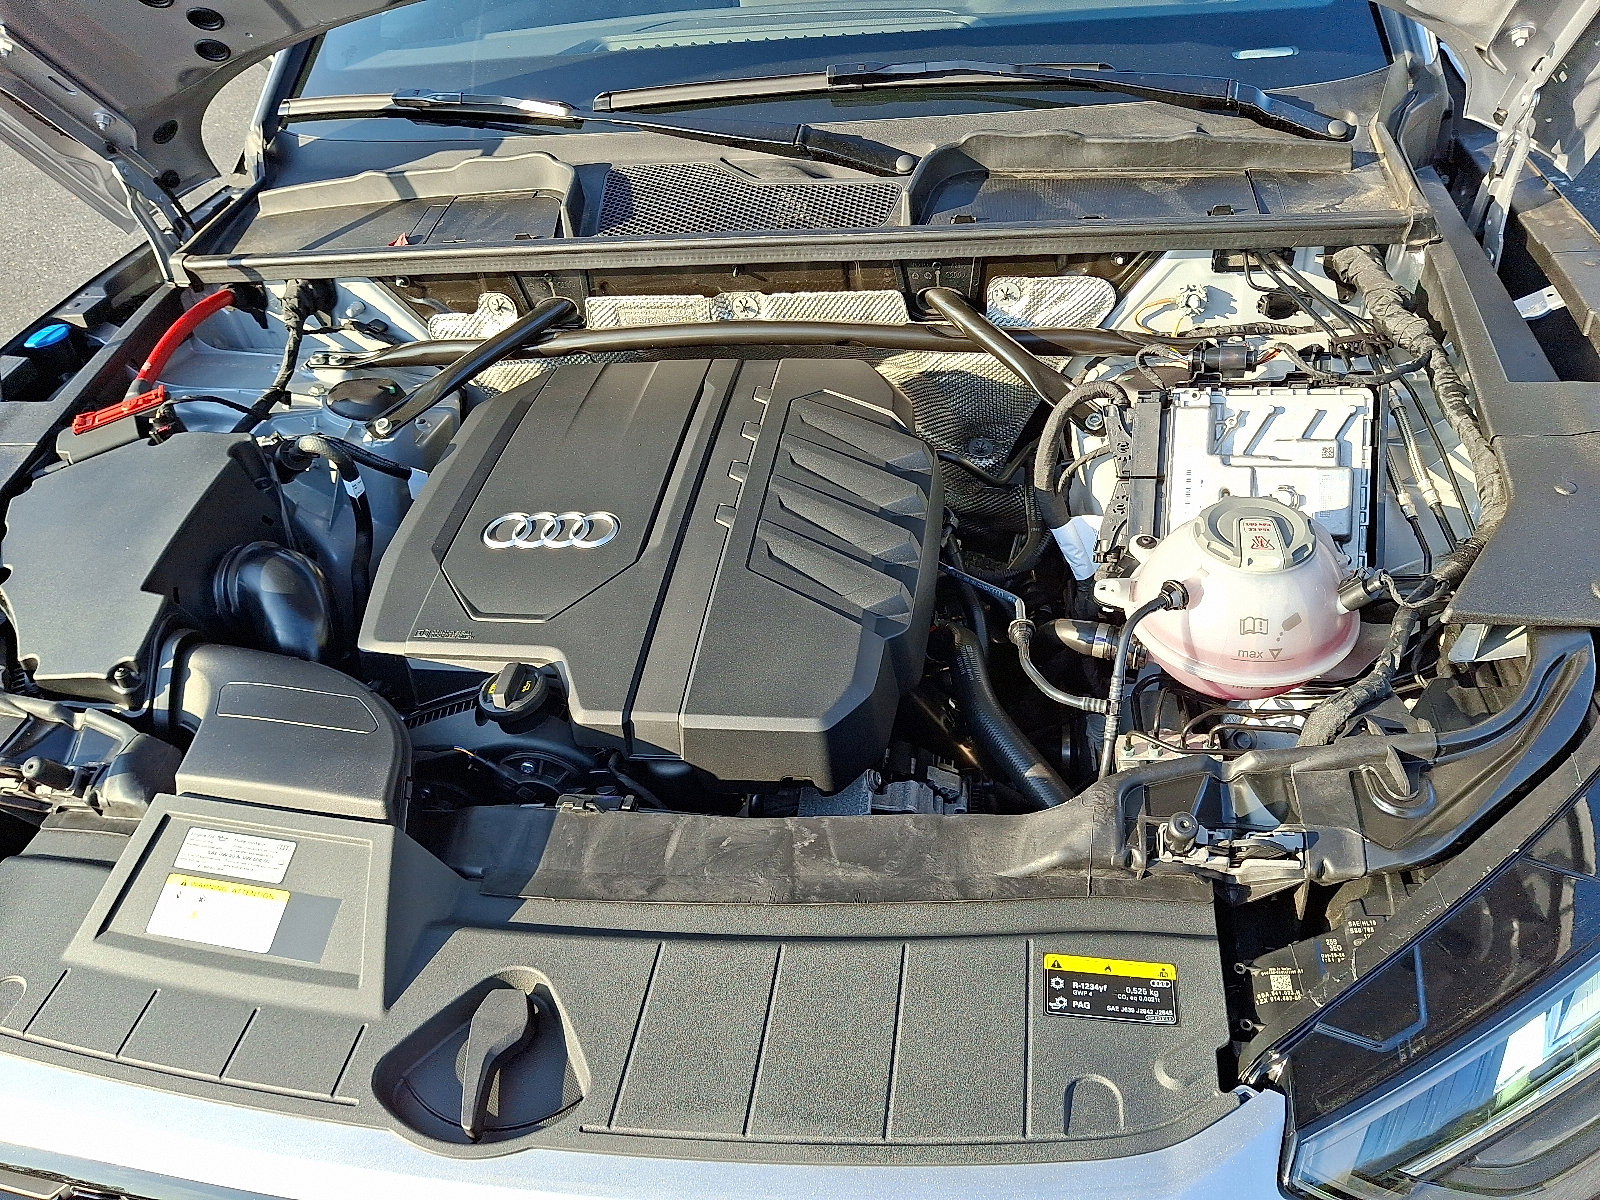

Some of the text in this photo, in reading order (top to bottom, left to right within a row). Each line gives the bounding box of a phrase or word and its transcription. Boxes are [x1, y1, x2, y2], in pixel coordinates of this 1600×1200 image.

[1237, 650, 1263, 659] max
[231, 887, 275, 900] ATTENTION
[1072, 981, 1108, 992] R-1234yf
[1125, 986, 1159, 997] 0,525 kg
[1072, 1000, 1091, 1010] PAG
[1106, 1004, 1120, 1012] SAE
